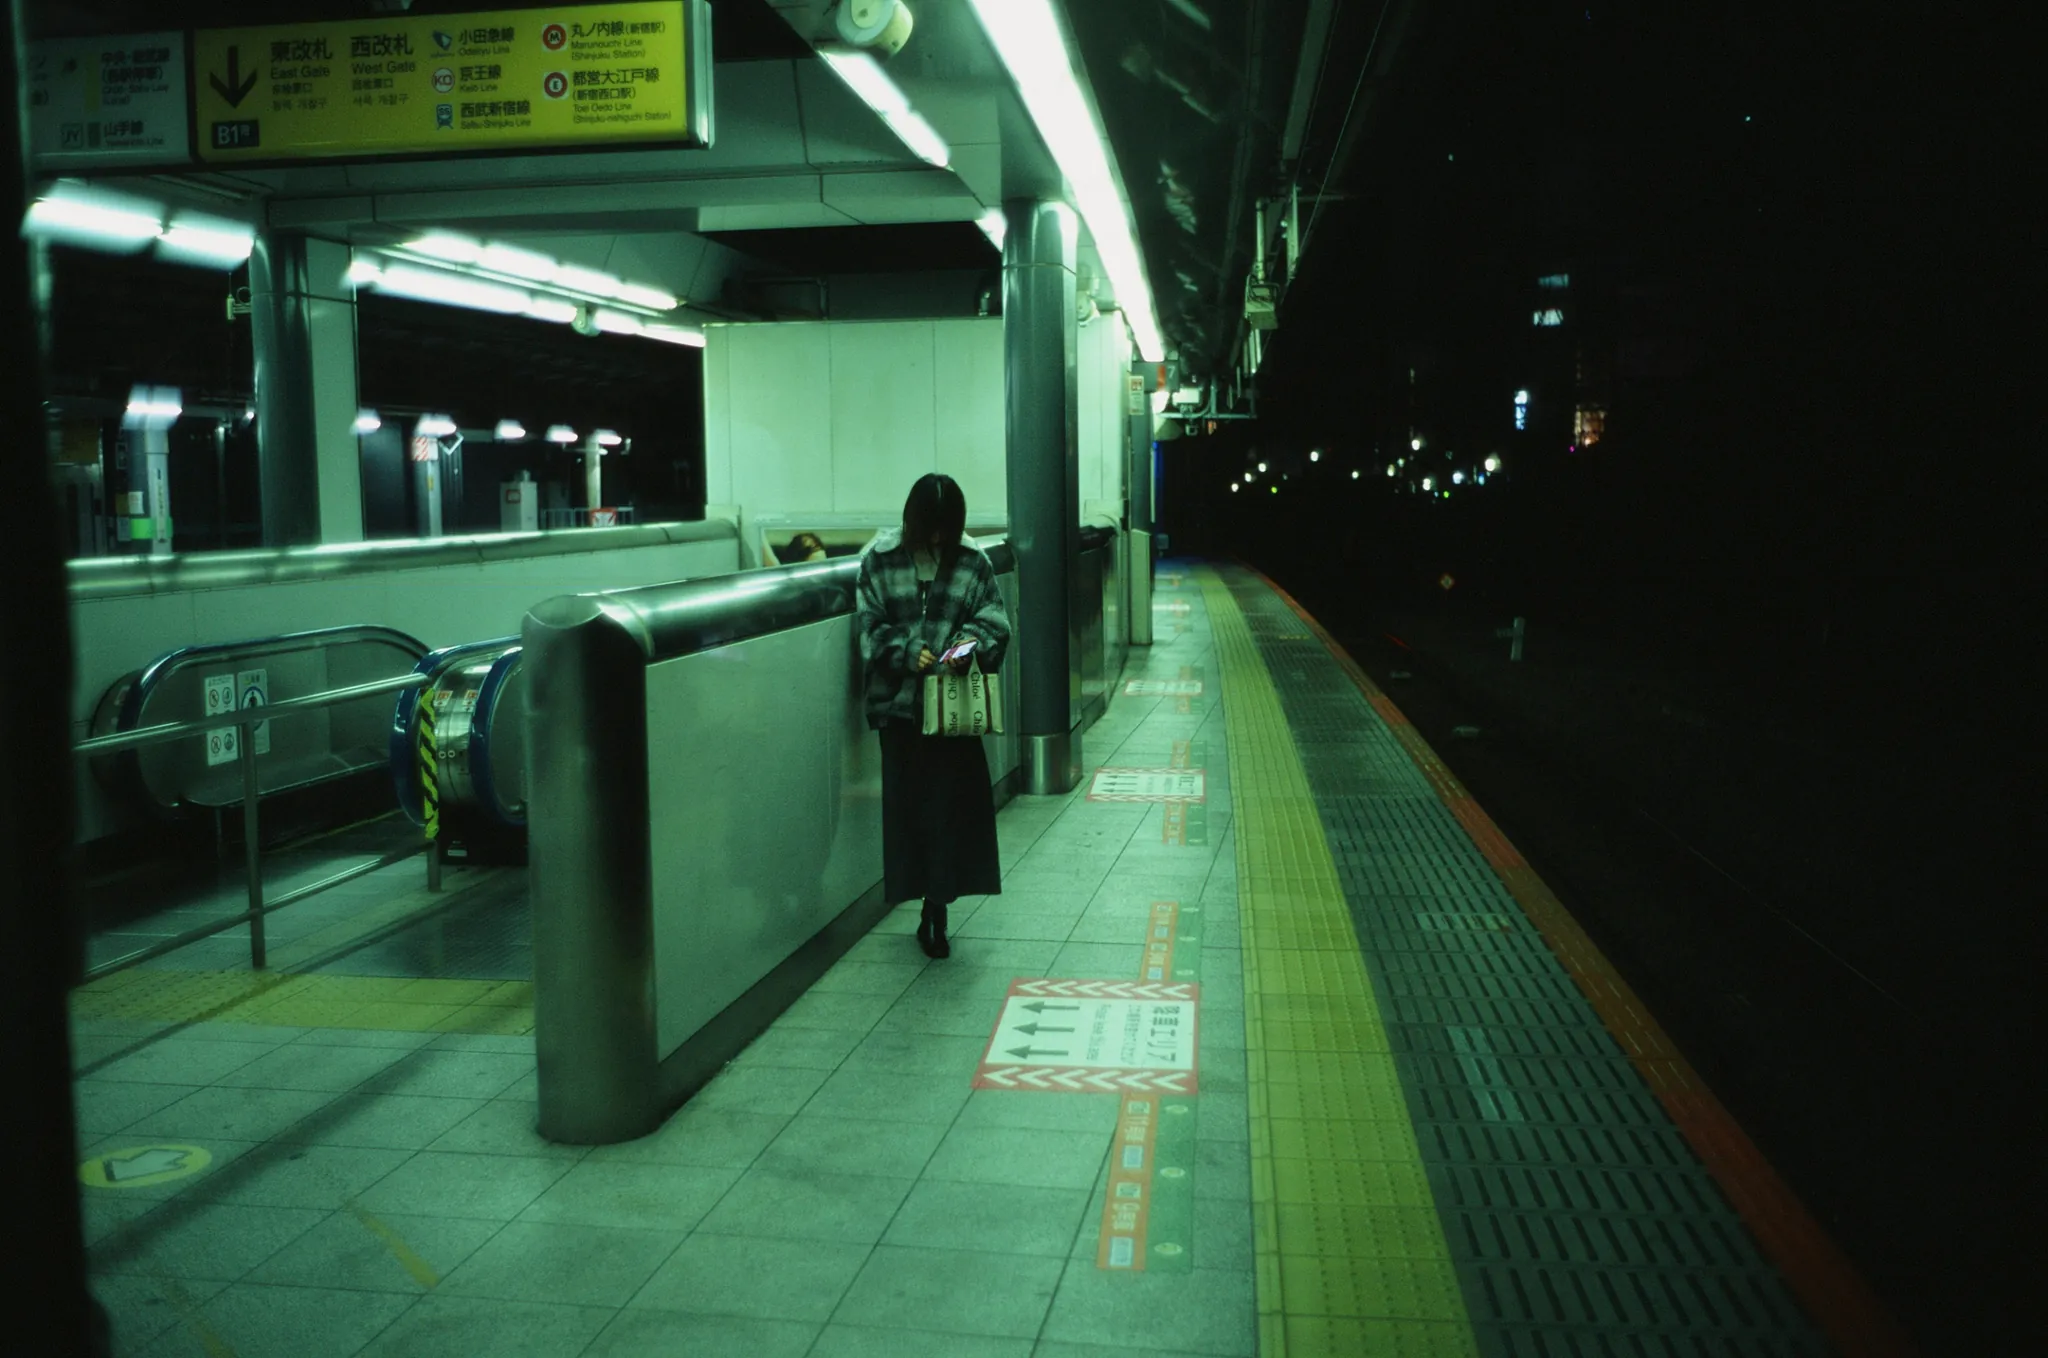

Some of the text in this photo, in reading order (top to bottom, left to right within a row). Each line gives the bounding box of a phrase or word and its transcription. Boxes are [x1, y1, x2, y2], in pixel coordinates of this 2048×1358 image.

[458, 26, 515, 45] 小田急線
[623, 38, 643, 47] Line
[270, 37, 333, 62] 東改札
[350, 32, 415, 58] 西改札
[270, 64, 331, 79] East Gate
[351, 60, 416, 75] West Gate
[460, 64, 501, 81] 京王線
[573, 67, 660, 86] 都営大江戸線
[460, 99, 531, 118] 西武新宿線
[615, 102, 632, 111] Line
[1168, 365, 1176, 379] 7
[948, 674, 957, 700] Chlo
